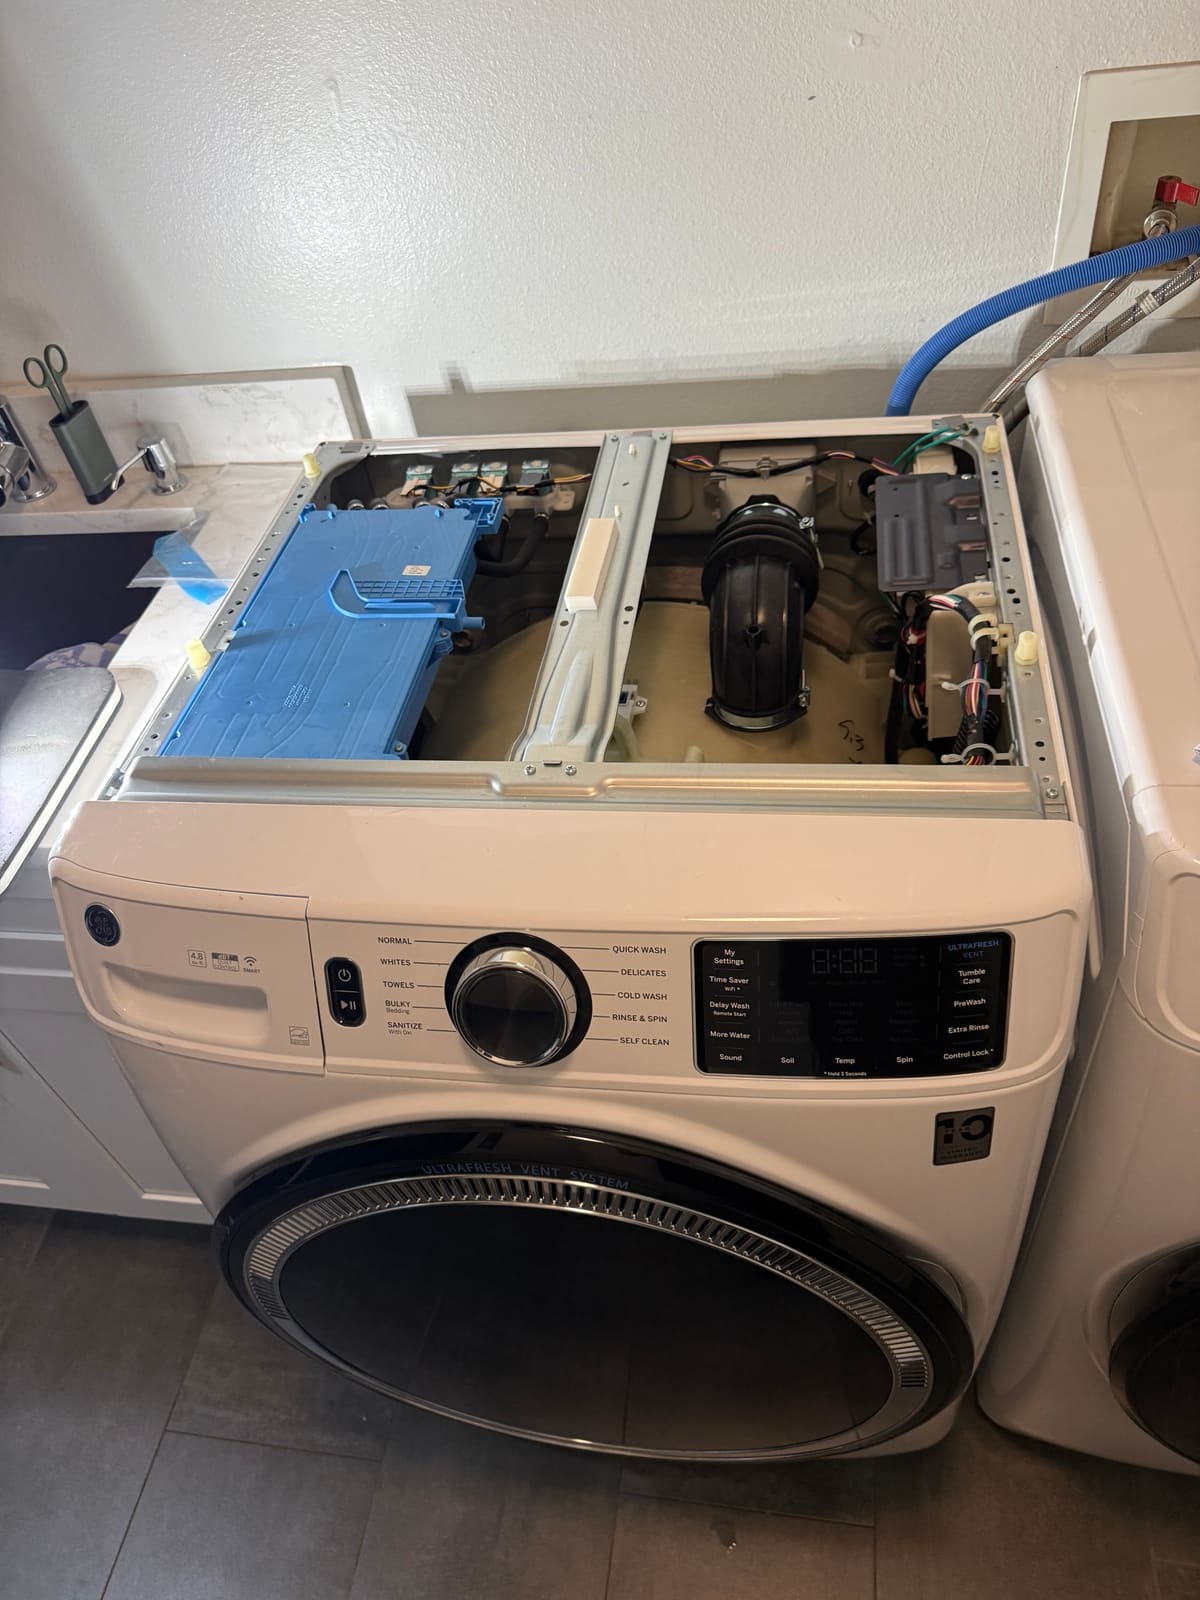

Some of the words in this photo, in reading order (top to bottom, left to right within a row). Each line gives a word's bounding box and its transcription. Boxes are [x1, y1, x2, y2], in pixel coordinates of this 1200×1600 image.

[377, 936, 413, 945] NORMAL
[612, 945, 640, 954] QUICK
[641, 946, 667, 954] WASH
[947, 939, 999, 952] ULTRAFRESH
[190, 952, 204, 961] 4.8
[724, 948, 735, 957] My
[962, 950, 985, 959] VENT
[380, 958, 412, 967] WHITES
[713, 957, 745, 966] Settings
[621, 968, 667, 977] DELICATES
[957, 968, 987, 977] Tumble
[383, 980, 415, 989] TOWELS
[709, 975, 728, 984] Time
[728, 976, 749, 985] Saver
[962, 977, 982, 985] Care
[617, 991, 641, 1000] COLD
[642, 992, 668, 1001] WASH
[385, 1000, 411, 1008] BULKY
[709, 1001, 730, 1010] Delay
[730, 1002, 750, 1010] Wash
[953, 998, 987, 1008] PreWash
[386, 1007, 411, 1015] Bedding
[612, 1013, 638, 1022] RINSE
[647, 1015, 668, 1023] SPIN
[387, 1021, 423, 1030] SANITIZE
[947, 1024, 968, 1034] Extra
[968, 1023, 990, 1032] Rinse
[709, 1030, 729, 1039] More
[729, 1031, 751, 1040] Water
[619, 1036, 640, 1045] SELF
[641, 1037, 670, 1046] CLEAN
[719, 1053, 743, 1062] Sound
[943, 1050, 971, 1060] Control
[971, 1048, 990, 1057] Lock
[780, 1056, 795, 1064] Soil
[835, 1057, 856, 1065] Temp
[896, 1056, 914, 1064] Spin
[419, 1162, 513, 1175] ULTRAFRESH
[519, 1164, 561, 1177] VENT
[569, 1169, 630, 1191] SYSTEM
